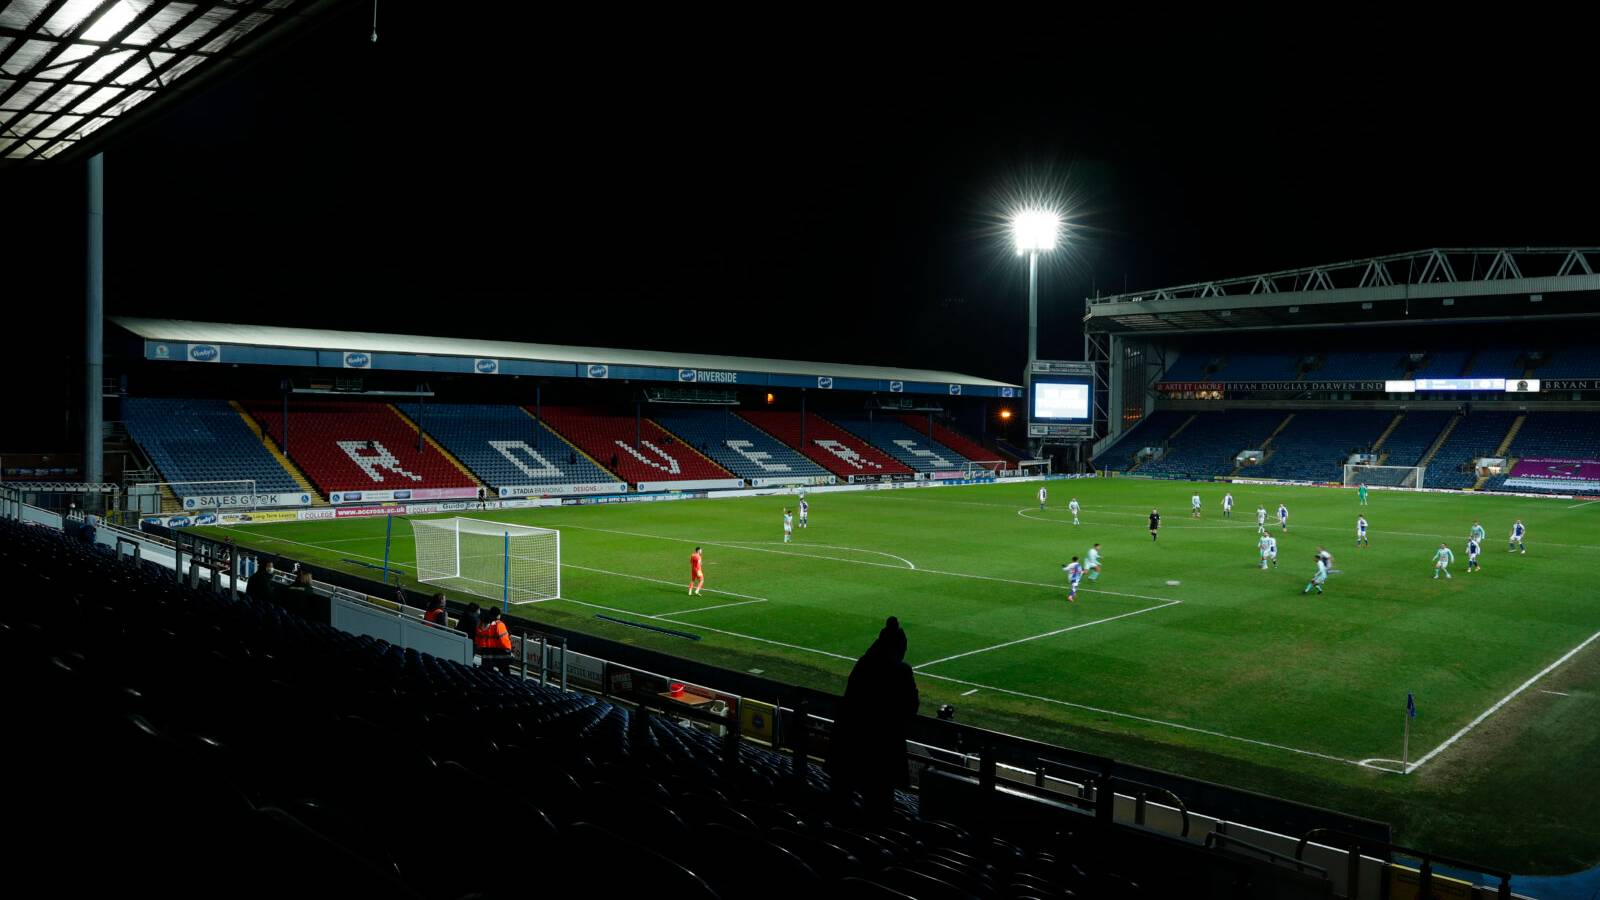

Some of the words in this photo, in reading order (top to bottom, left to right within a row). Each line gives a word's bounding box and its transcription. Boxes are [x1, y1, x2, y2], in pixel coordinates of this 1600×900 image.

[697, 370, 737, 384] RIVERSIDE
[1228, 383, 1257, 391] BRYAN
[1261, 383, 1306, 391] DOUGLAS
[1312, 383, 1355, 391] DARWEN
[1361, 383, 1383, 391] END
[1546, 381, 1587, 389] BRYAN
[512, 487, 534, 495] STADIA
[201, 496, 238, 506] SALES
[305, 512, 333, 520] COLLEGE
